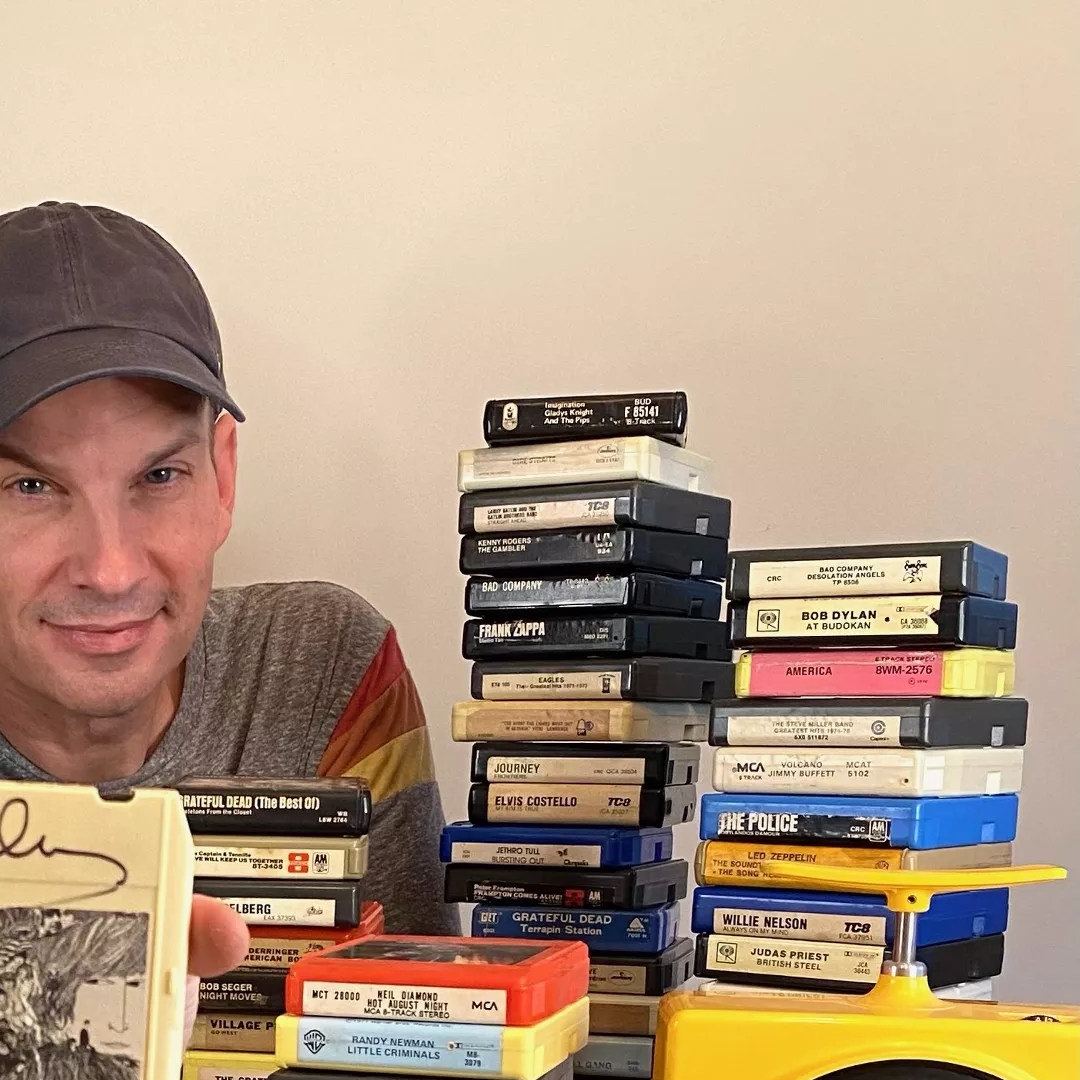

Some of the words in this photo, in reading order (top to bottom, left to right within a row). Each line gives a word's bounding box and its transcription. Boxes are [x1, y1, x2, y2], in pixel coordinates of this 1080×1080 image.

[482, 580, 499, 592] BAD
[502, 580, 542, 592] COMPANY
[802, 610, 829, 621] BOB
[832, 609, 877, 621] DYLAN
[479, 622, 511, 638] FRANK
[513, 622, 545, 636] ZAPPA
[806, 622, 819, 630] AT
[822, 621, 871, 631] BUDOKAN
[786, 666, 833, 676] AMERICA
[876, 664, 933, 675] 8WM-2576
[494, 763, 540, 774] JOURNEY
[495, 796, 523, 807] ELVIS
[527, 796, 577, 807] COSTELLO
[720, 813, 745, 832] THE
[748, 813, 799, 833] POLICE
[512, 912, 576, 924] GRATEFUL
[580, 914, 612, 925] DEAD
[723, 914, 760, 929] WILLIE
[764, 917, 807, 930] NELSON
[843, 922, 871, 933] TC8
[750, 949, 787, 959] JUDAS
[789, 952, 829, 962] PRIEST
[378, 990, 396, 1001] NEIL
[402, 991, 439, 1002] DIAMOND
[367, 999, 383, 1009] HOT
[387, 999, 419, 1010] AUGUST
[423, 1001, 449, 1012] NIGHT
[352, 1036, 388, 1047] RANDY
[391, 1037, 435, 1049] NEWMAN
[347, 1046, 381, 1058] LITTLE
[384, 1047, 441, 1060] CRIMINALS
